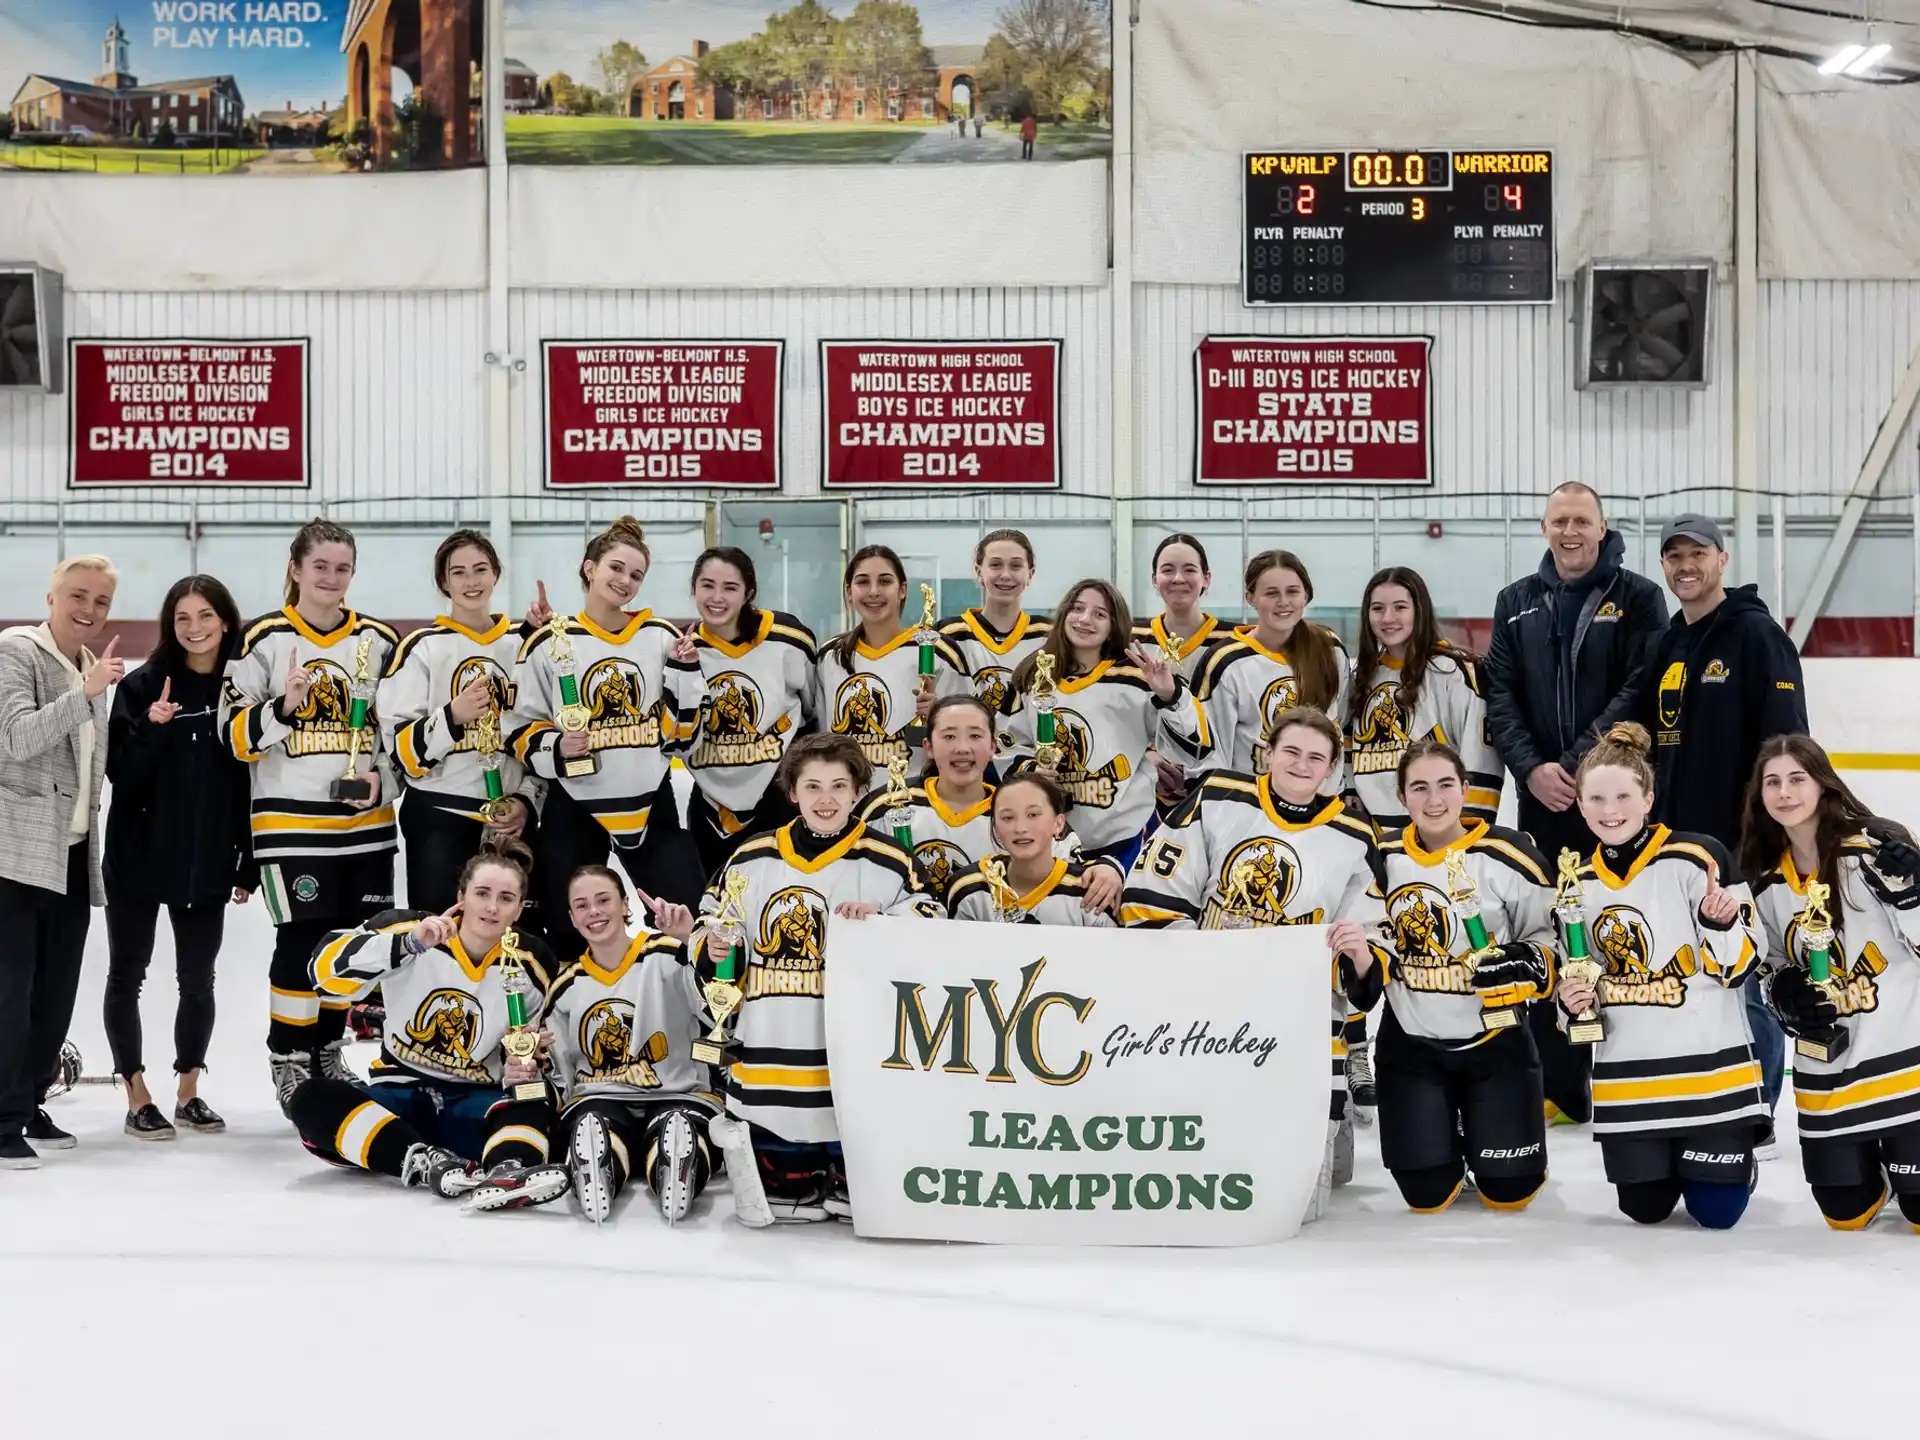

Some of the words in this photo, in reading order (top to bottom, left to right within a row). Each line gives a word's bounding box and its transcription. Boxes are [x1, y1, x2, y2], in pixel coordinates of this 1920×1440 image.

[152, 1, 236, 22] WORK
[245, 2, 328, 23] HARD.
[152, 27, 217, 48] PLAY
[227, 27, 311, 48] HARD.
[1454, 154, 1549, 173] WARRIOR
[1296, 185, 1314, 214] 2
[1504, 185, 1522, 210] 4
[1361, 203, 1404, 216] PERIOD
[1412, 198, 1424, 220] 3
[1254, 227, 1283, 240] PLYR
[1293, 227, 1344, 240] PENALTY
[1454, 226, 1483, 239] PLYR
[1493, 225, 1544, 238] PENALTY
[102, 348, 246, 362] WATERTOWN-BELMONT
[251, 348, 276, 362] H.S.
[576, 349, 721, 363] WATERTOWN-BELMONT
[725, 349, 750, 363] H.S.
[859, 353, 937, 367] WATERTOWN
[941, 353, 971, 367] HIGH
[975, 353, 1024, 367] SCHOOL
[1232, 349, 1310, 363] WATERTOWN
[1315, 349, 1344, 363] HIGH
[1349, 349, 1397, 363] SCHOOL
[106, 365, 201, 383] MIDDLESEX
[207, 365, 272, 383] LEAGUE
[579, 366, 674, 384] MIDDLESEX
[681, 366, 746, 384] LEAGUE
[851, 372, 953, 392] MIDDLESEX
[962, 372, 1032, 392] LEAGUE
[1253, 369, 1303, 388] BOYS
[1311, 369, 1339, 388] ICE
[1347, 369, 1421, 388] HOCKEY
[110, 384, 188, 402] FREEDOM
[195, 384, 269, 402] DIVISION
[583, 386, 661, 404] FREEDOM
[668, 386, 742, 403] DIVISION
[1258, 392, 1372, 416] STATE
[122, 406, 164, 422] GIRLS
[170, 406, 192, 422] ICE
[198, 406, 256, 422] HOCKEY
[596, 407, 638, 423] GIRLS
[643, 407, 666, 423] ICE
[671, 407, 729, 423] HOCKEY
[857, 397, 908, 416] BOYS
[915, 397, 944, 416] ICE
[952, 397, 1025, 416] HOCKEY
[89, 426, 290, 450] CHAMPIONS
[564, 428, 762, 452] CHAMPIONS
[840, 422, 1045, 446] CHAMPIONS
[1213, 420, 1419, 443] CHAMPIONS
[150, 453, 228, 476] 2014
[625, 454, 701, 478] 2015
[903, 452, 980, 476] 2014
[1277, 449, 1354, 472] 2015
[588, 717, 660, 750] ARRIORS
[747, 966, 825, 998] WARRIO
[881, 955, 1097, 1086] MYC
[1101, 1022, 1174, 1067] Girl's
[1179, 1020, 1277, 1068] Hockey
[968, 1110, 1206, 1152] LEAGUE
[903, 1165, 1254, 1211] CHAMPIONS
